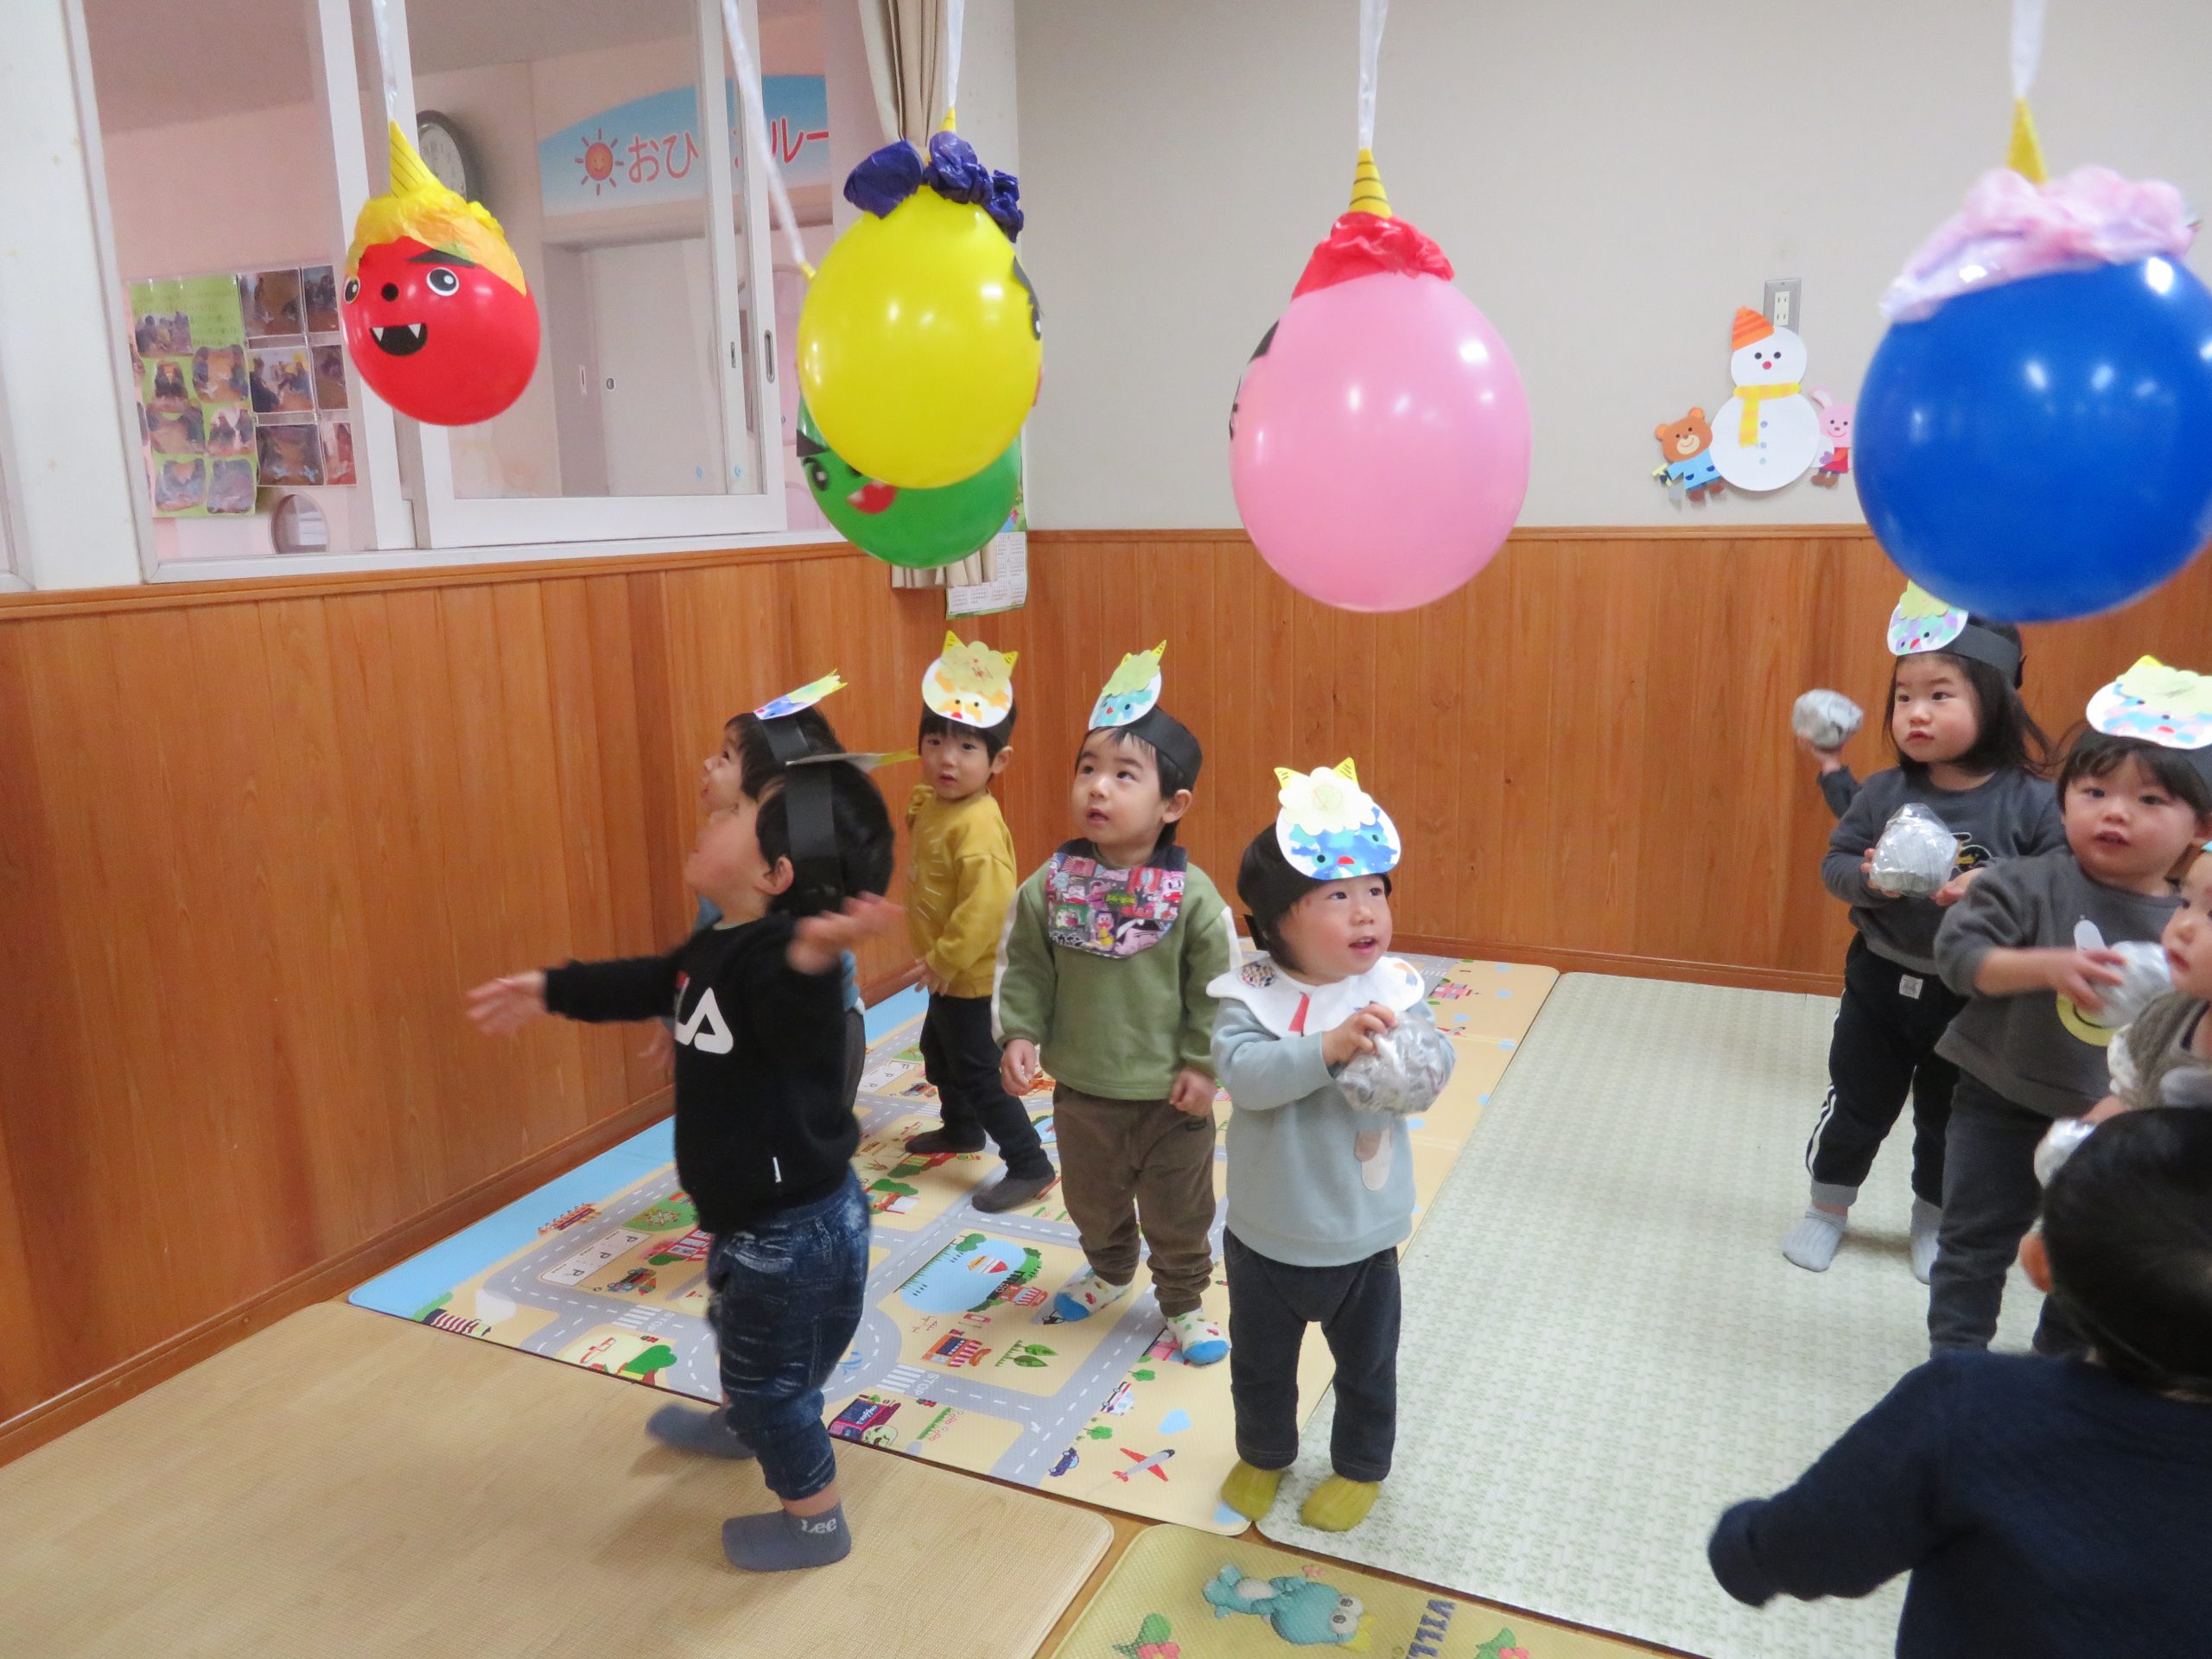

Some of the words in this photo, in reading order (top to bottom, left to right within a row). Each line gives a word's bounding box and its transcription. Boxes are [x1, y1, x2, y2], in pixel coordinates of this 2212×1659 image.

[913, 1372, 940, 1396] STOP
[800, 1517, 837, 1534] Lee
[1405, 1599, 1457, 1659] VILL
